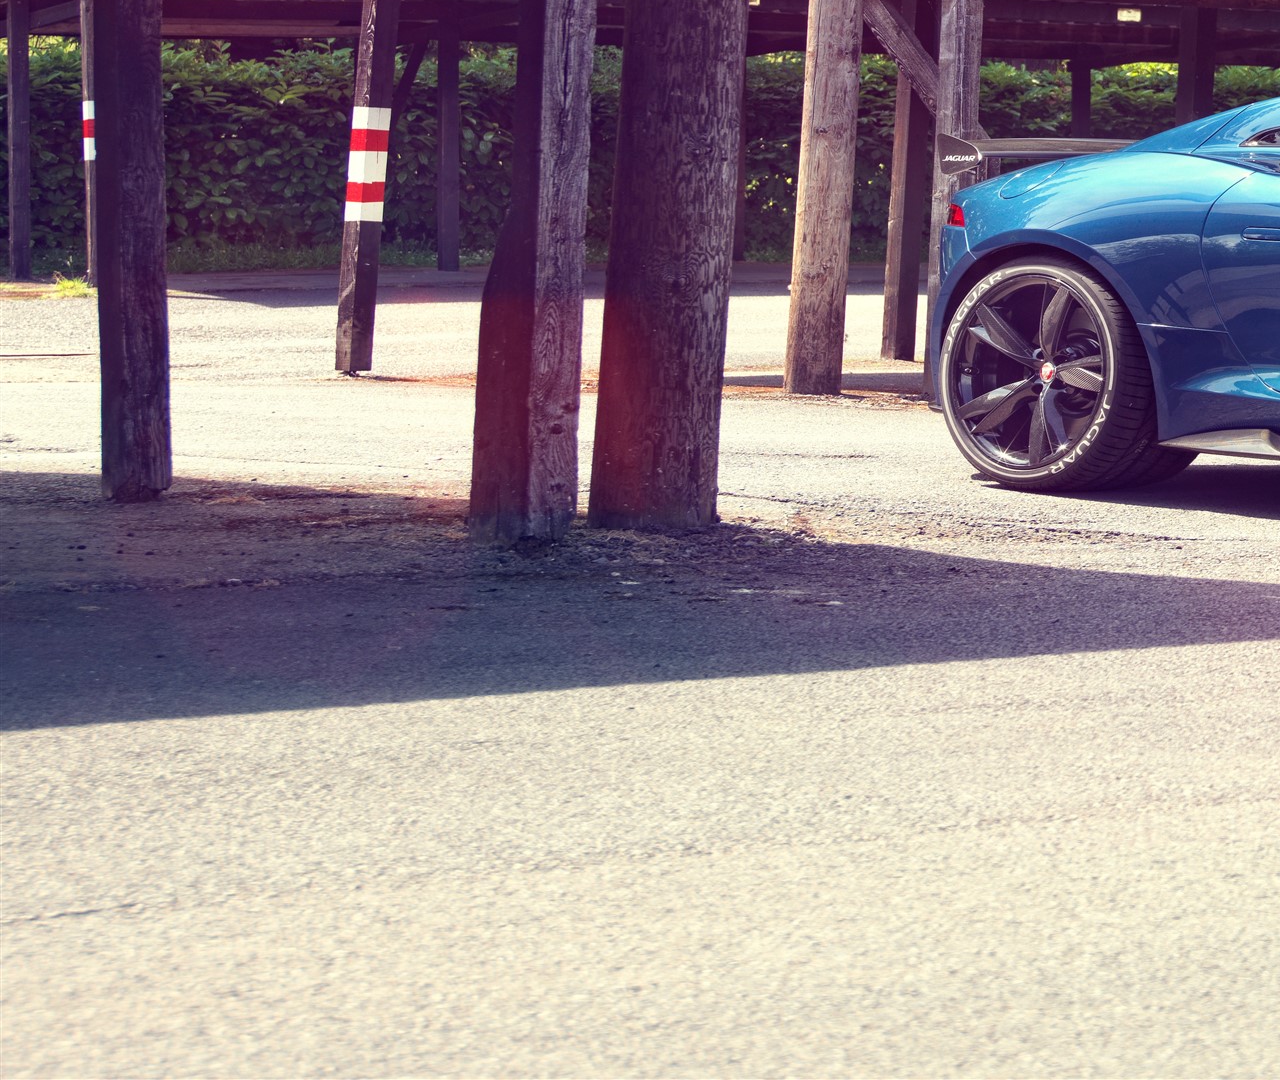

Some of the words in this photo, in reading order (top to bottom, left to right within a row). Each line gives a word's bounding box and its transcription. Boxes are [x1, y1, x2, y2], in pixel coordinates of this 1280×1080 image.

[942, 154, 976, 162] JAGUAR
[947, 271, 1002, 351] JAGUAR
[1049, 393, 1111, 475] JAGUAR
